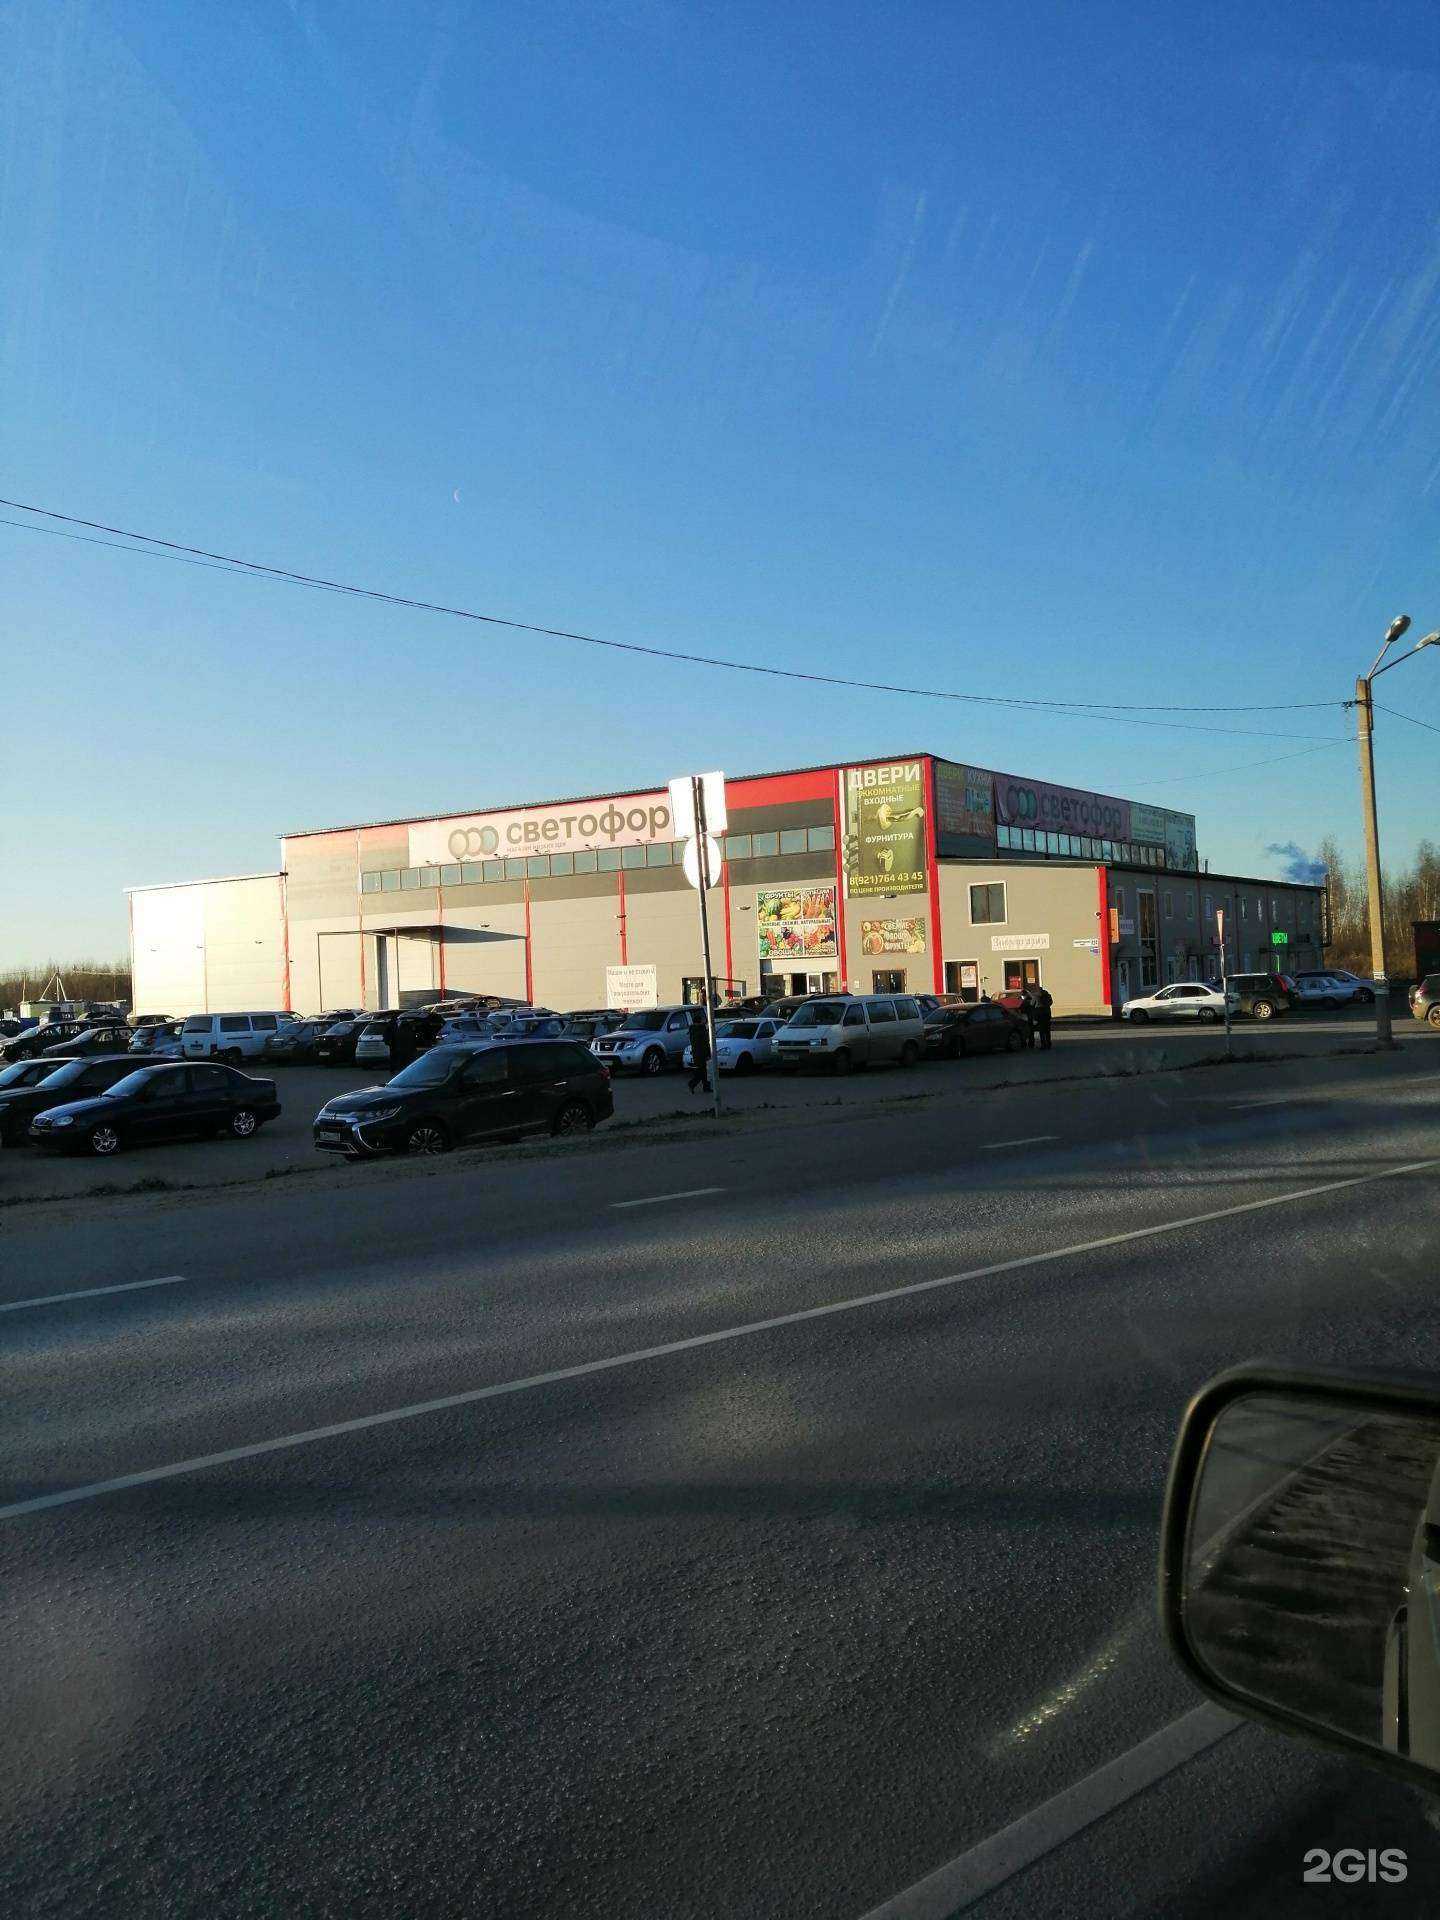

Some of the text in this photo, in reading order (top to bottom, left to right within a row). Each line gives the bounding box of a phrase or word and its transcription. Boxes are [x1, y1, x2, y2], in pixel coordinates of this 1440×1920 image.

[849, 764, 920, 790] ДВЕРИ
[864, 794, 904, 805] ВХОДНЫЕ
[1040, 793, 1122, 834] светофор
[506, 802, 670, 844] светофор
[866, 832, 914, 843] ФУРНИТУРА
[849, 872, 923, 887] 8(921)764 43 45
[765, 891, 794, 899] ФРУКТЫ
